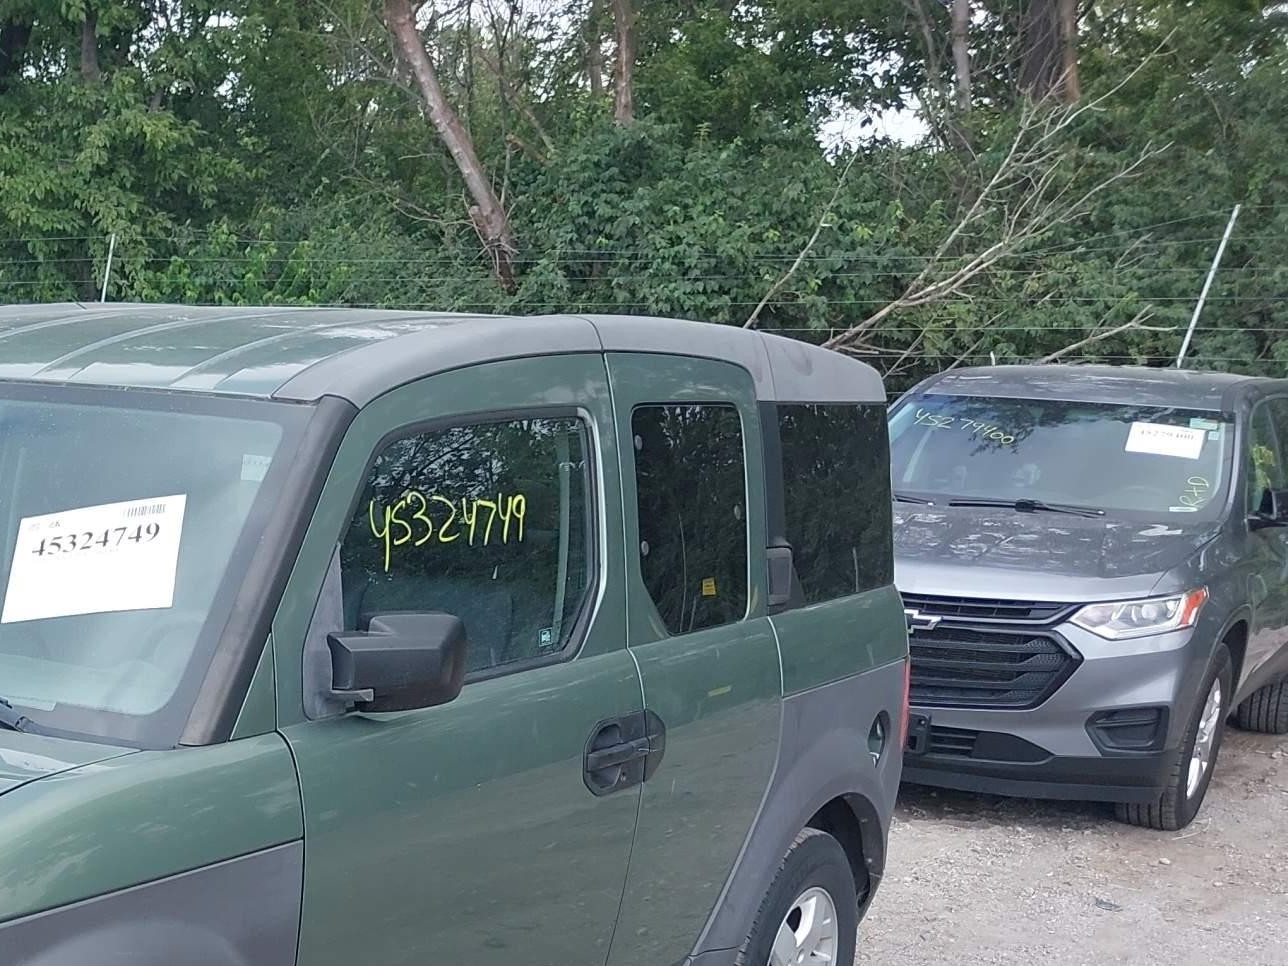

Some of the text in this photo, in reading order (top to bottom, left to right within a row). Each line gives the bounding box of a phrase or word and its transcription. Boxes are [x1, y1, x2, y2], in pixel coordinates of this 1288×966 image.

[914, 407, 1015, 444] 45279400
[31, 522, 161, 556] 45324749
[369, 490, 526, 573] 45324749
